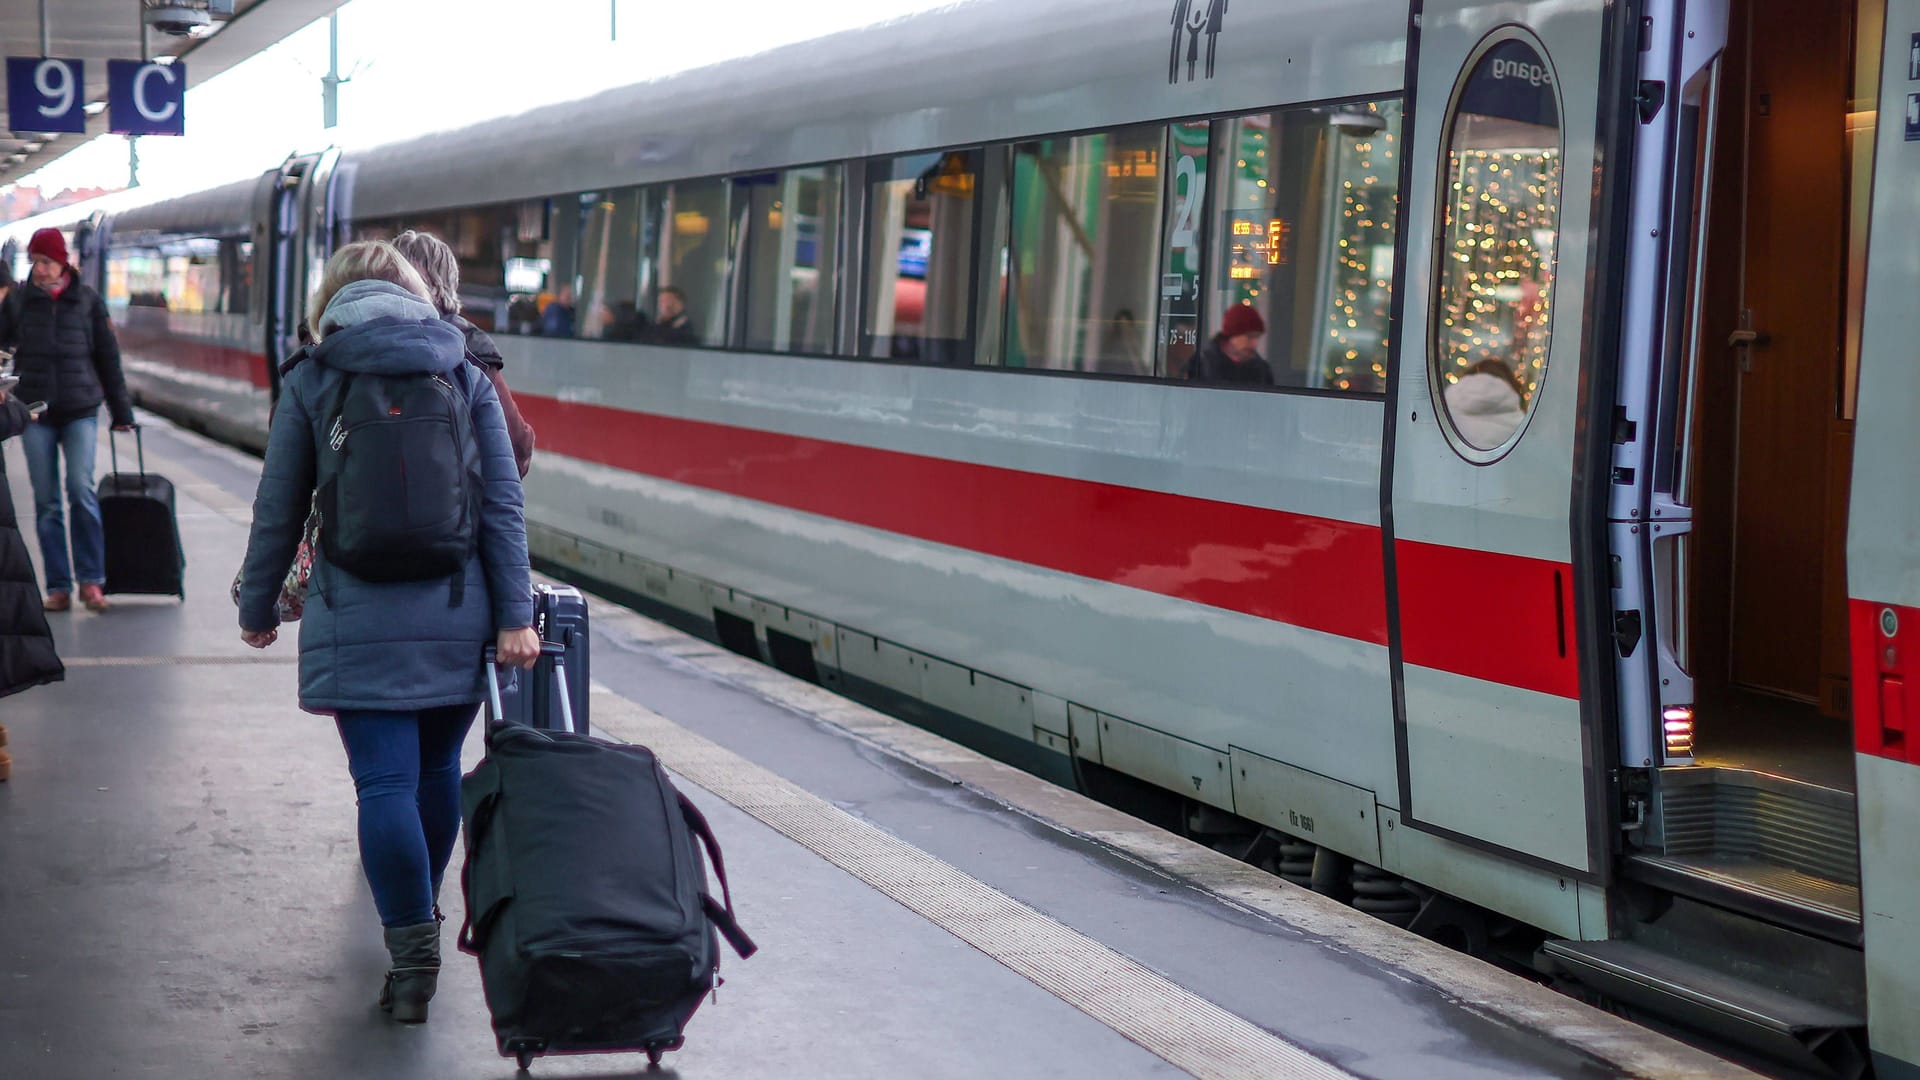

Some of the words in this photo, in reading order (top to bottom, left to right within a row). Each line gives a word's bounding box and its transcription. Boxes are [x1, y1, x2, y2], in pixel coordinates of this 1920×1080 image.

[34, 58, 75, 119] 9
[133, 63, 178, 123] C
[1172, 154, 1197, 248] 2
